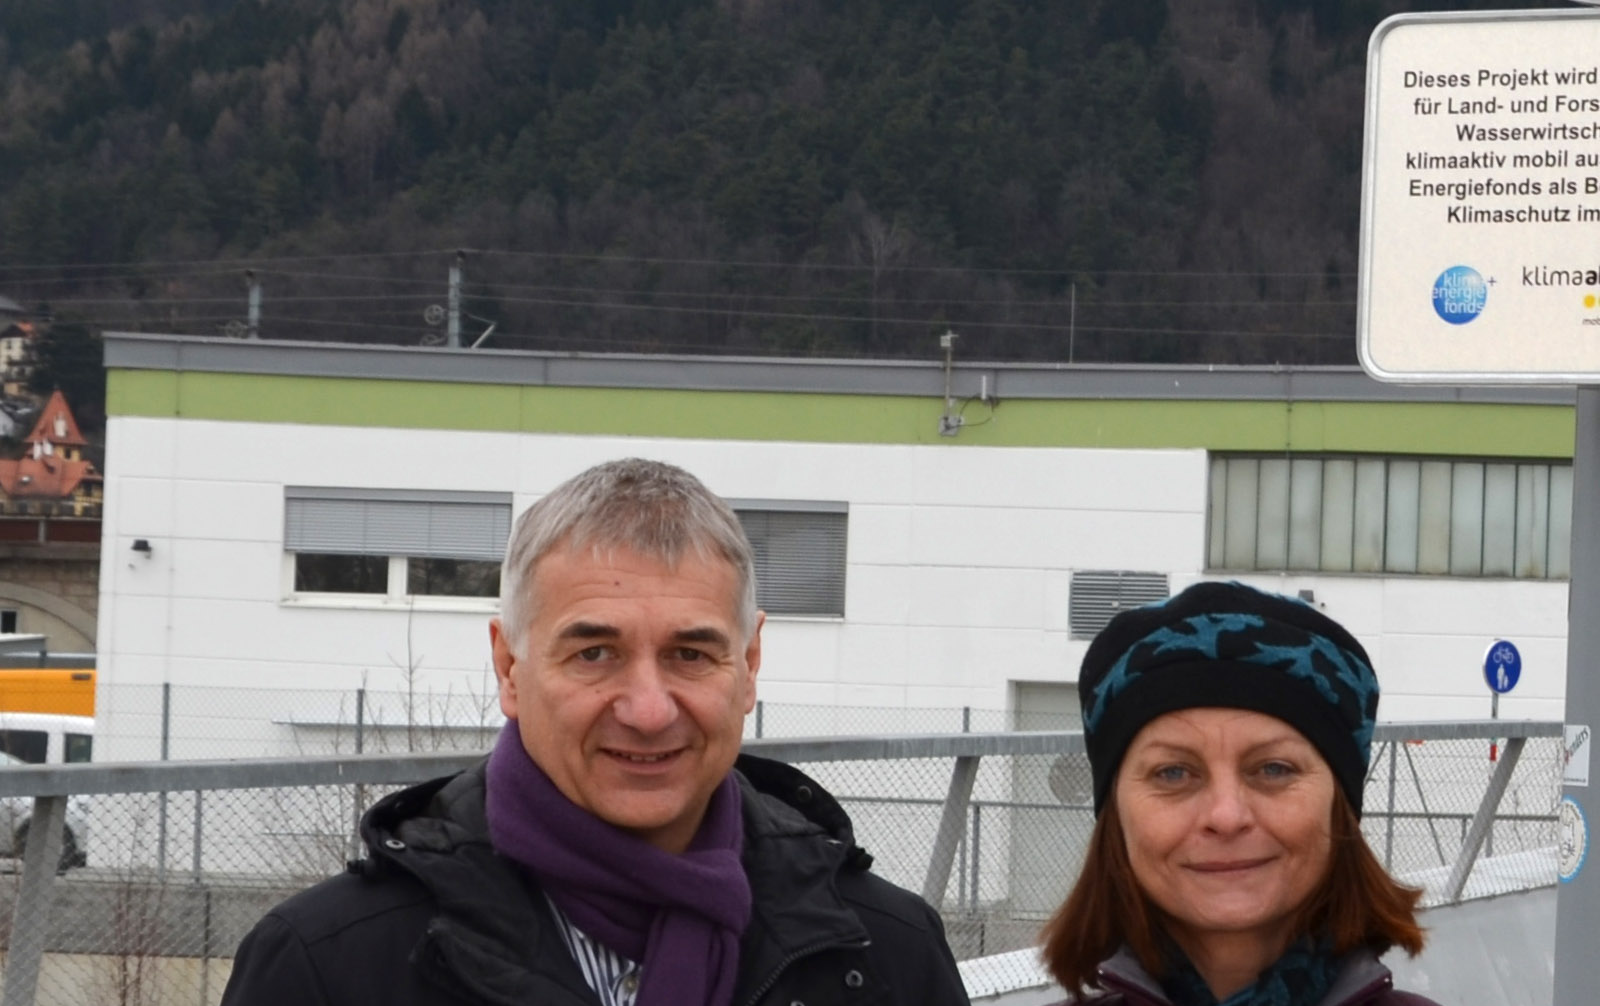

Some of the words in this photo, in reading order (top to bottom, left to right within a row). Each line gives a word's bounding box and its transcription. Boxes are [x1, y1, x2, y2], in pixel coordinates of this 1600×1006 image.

[1404, 71, 1471, 88] Dieses
[1477, 68, 1549, 91] Projekt
[1554, 67, 1598, 85] wird
[1413, 97, 1442, 115] für
[1447, 96, 1504, 115] Land-
[1510, 95, 1548, 114] und
[1406, 151, 1507, 170] klimaaktiv
[1513, 150, 1568, 168] mobil
[1409, 177, 1542, 201] Energiefonds
[1548, 177, 1577, 195] als
[1447, 205, 1571, 224] Klimaschutz
[1577, 204, 1600, 222] im
[1432, 286, 1485, 303] energie
[1444, 298, 1485, 313] fonds
